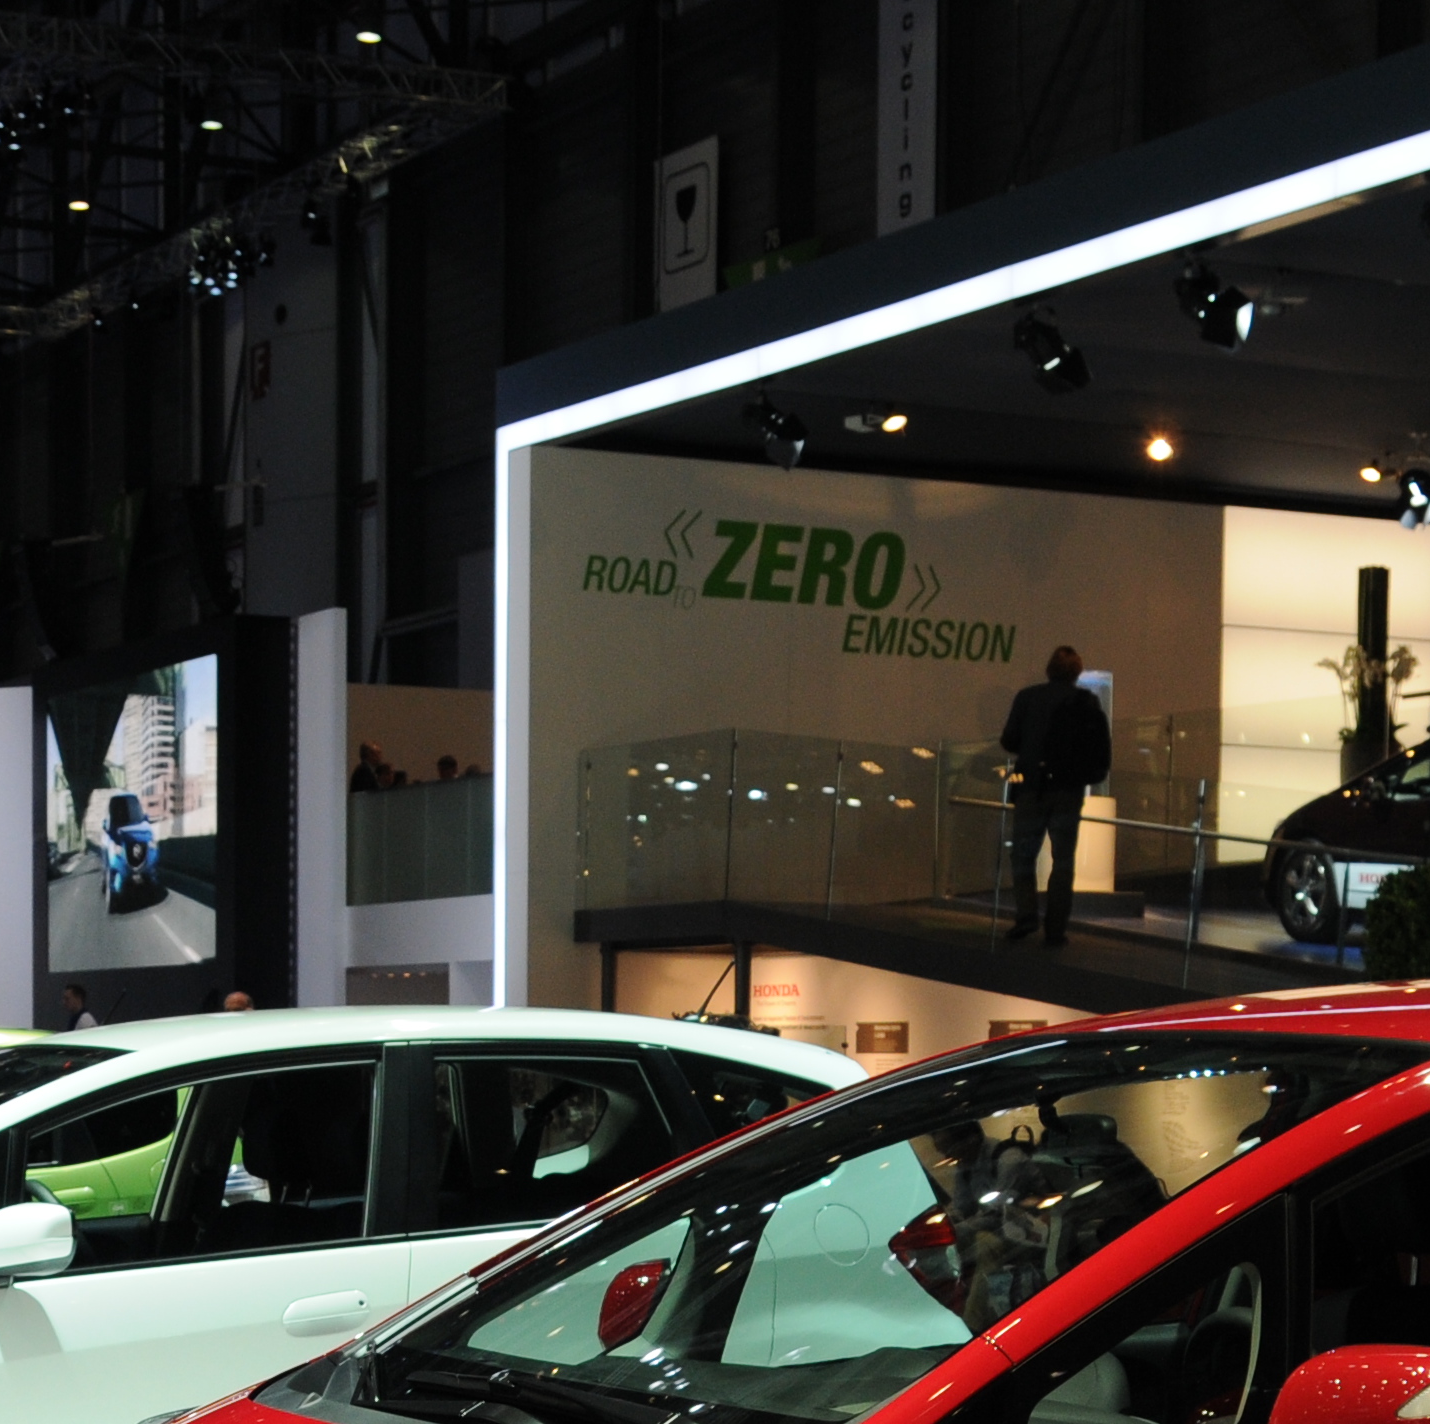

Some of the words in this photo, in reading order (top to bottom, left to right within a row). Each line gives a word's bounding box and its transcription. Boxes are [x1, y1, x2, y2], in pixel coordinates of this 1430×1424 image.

[898, 0, 915, 218] cycling
[582, 555, 678, 598] ROAD
[674, 585, 697, 611] TO
[702, 520, 906, 610] ZERO
[842, 615, 1017, 663] EMISSION
[753, 983, 801, 998] HONDA
